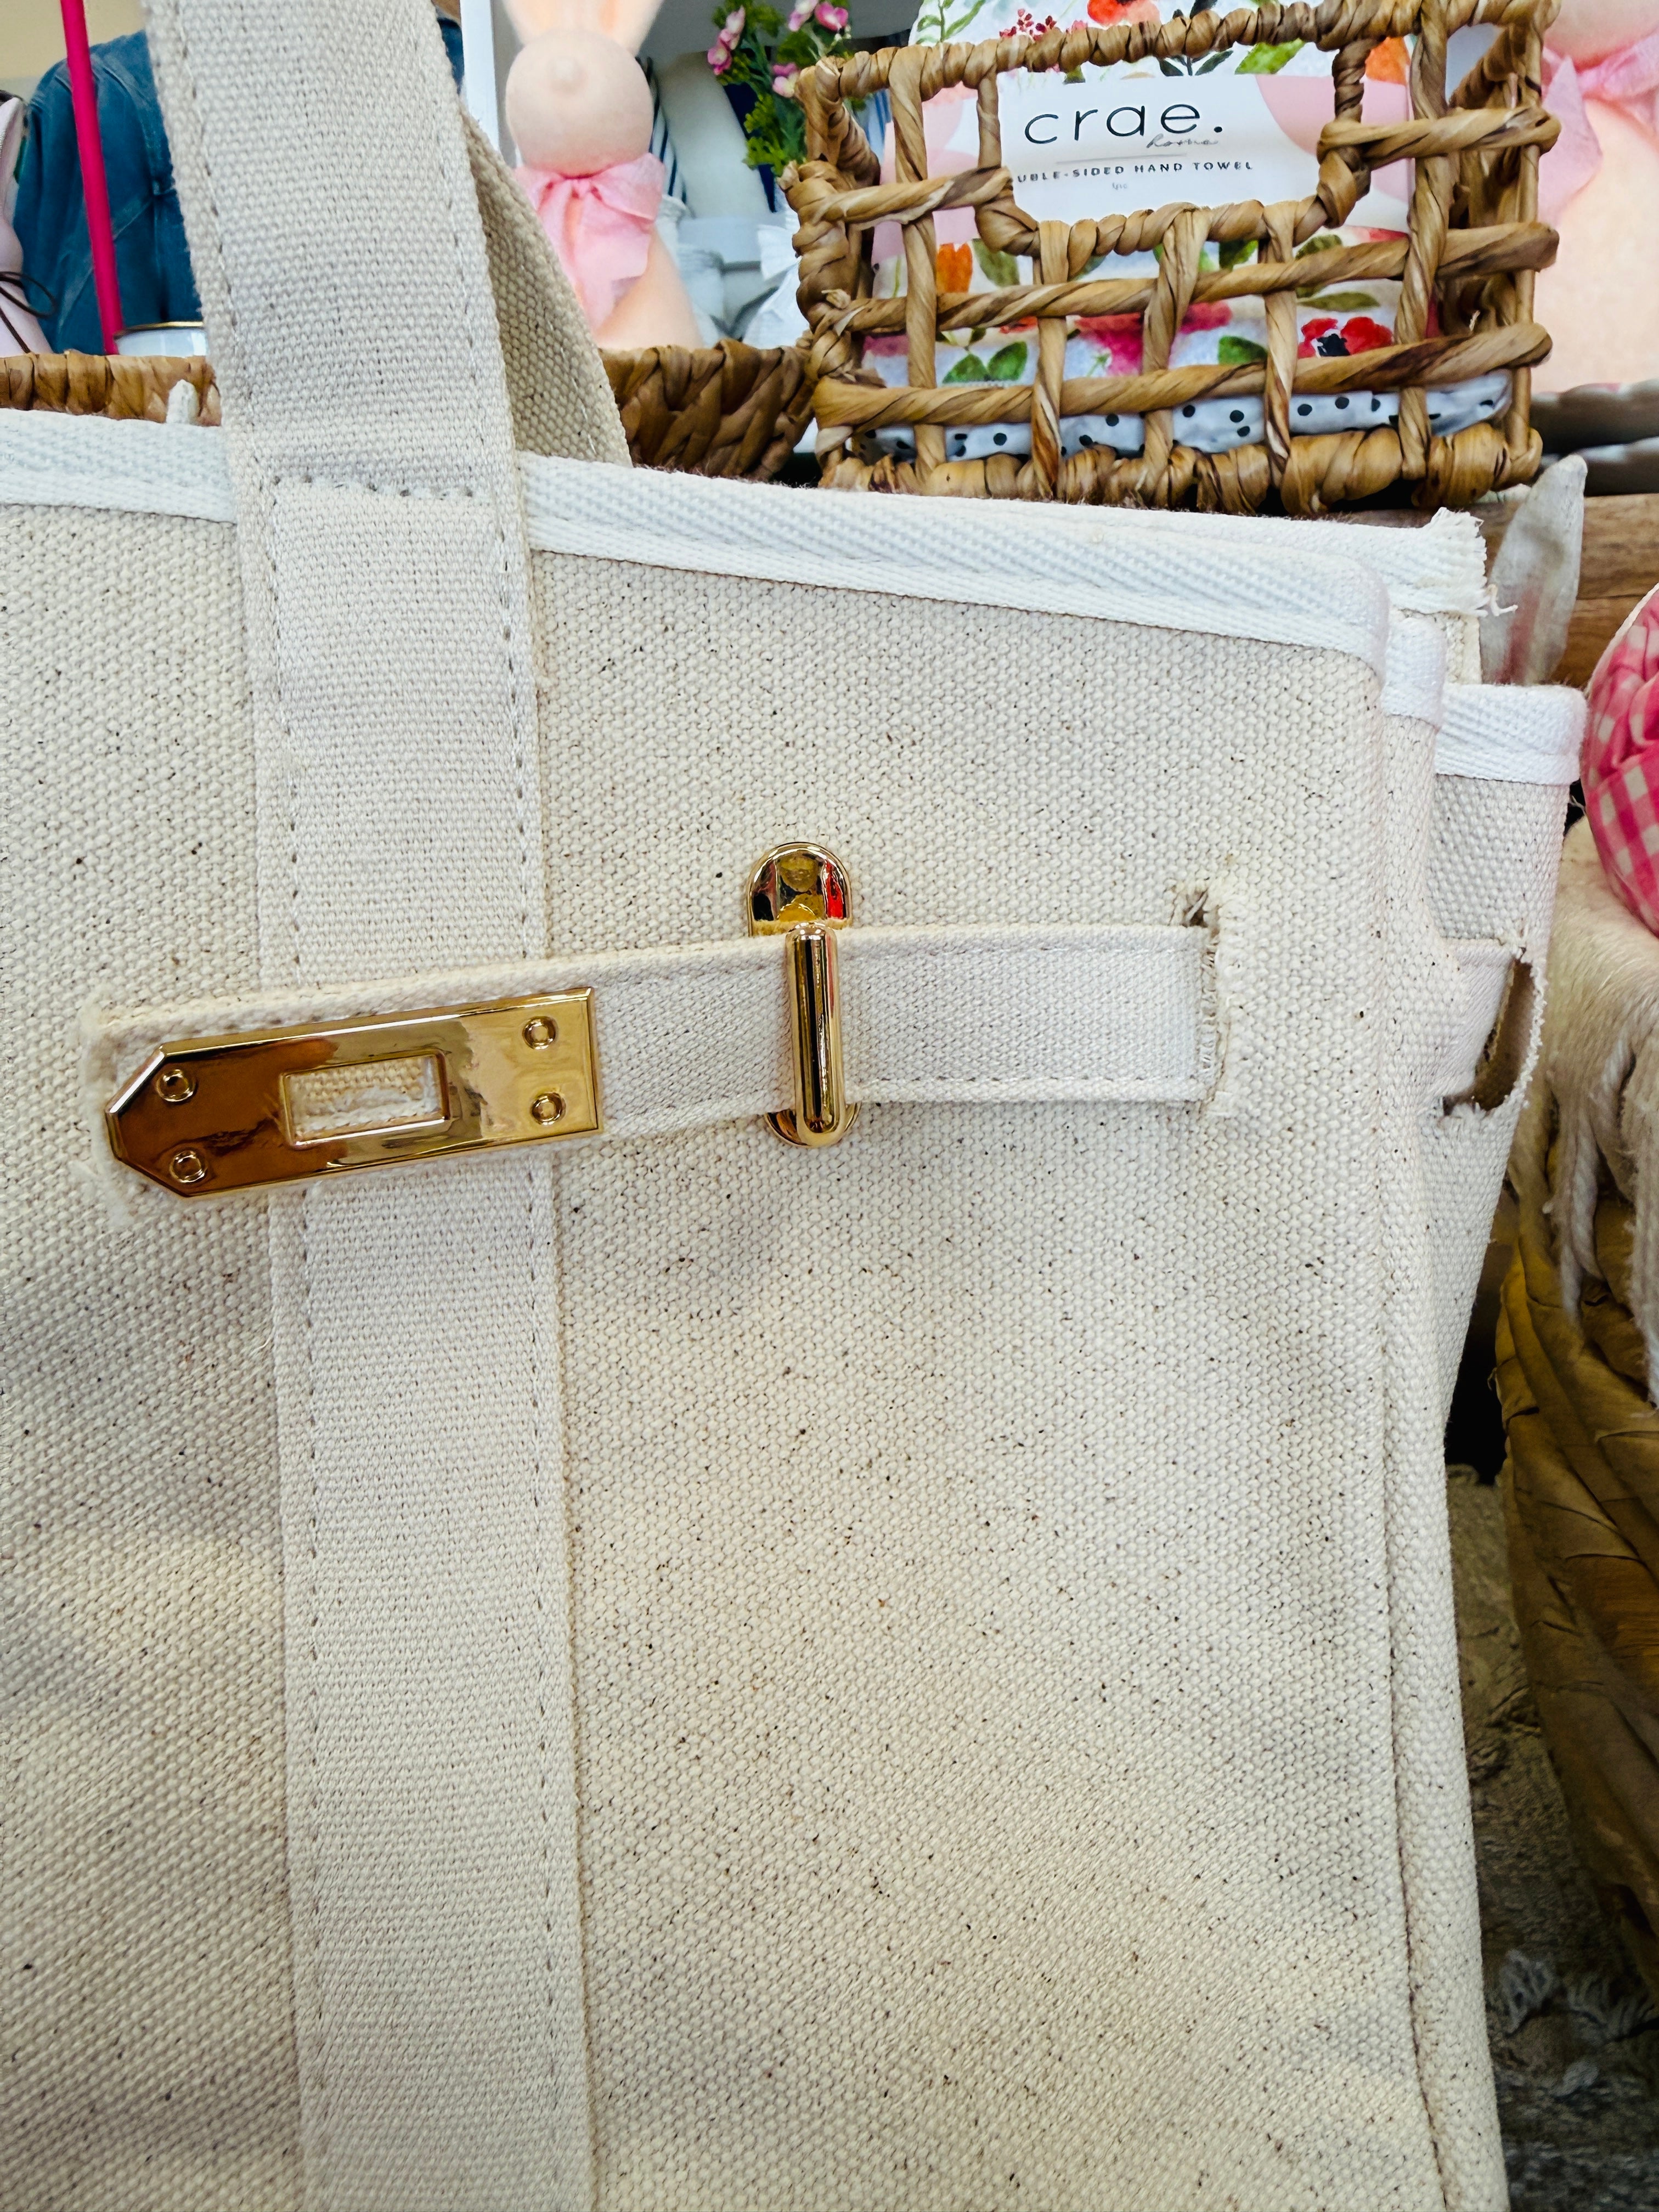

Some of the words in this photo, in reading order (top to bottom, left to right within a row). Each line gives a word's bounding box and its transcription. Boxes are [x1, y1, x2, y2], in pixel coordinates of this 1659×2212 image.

[1024, 104, 1223, 144] crae.
[1017, 166, 1124, 183] UBLE-SIDED
[1134, 163, 1183, 173] HAND
[1193, 161, 1253, 171] TOWEL
